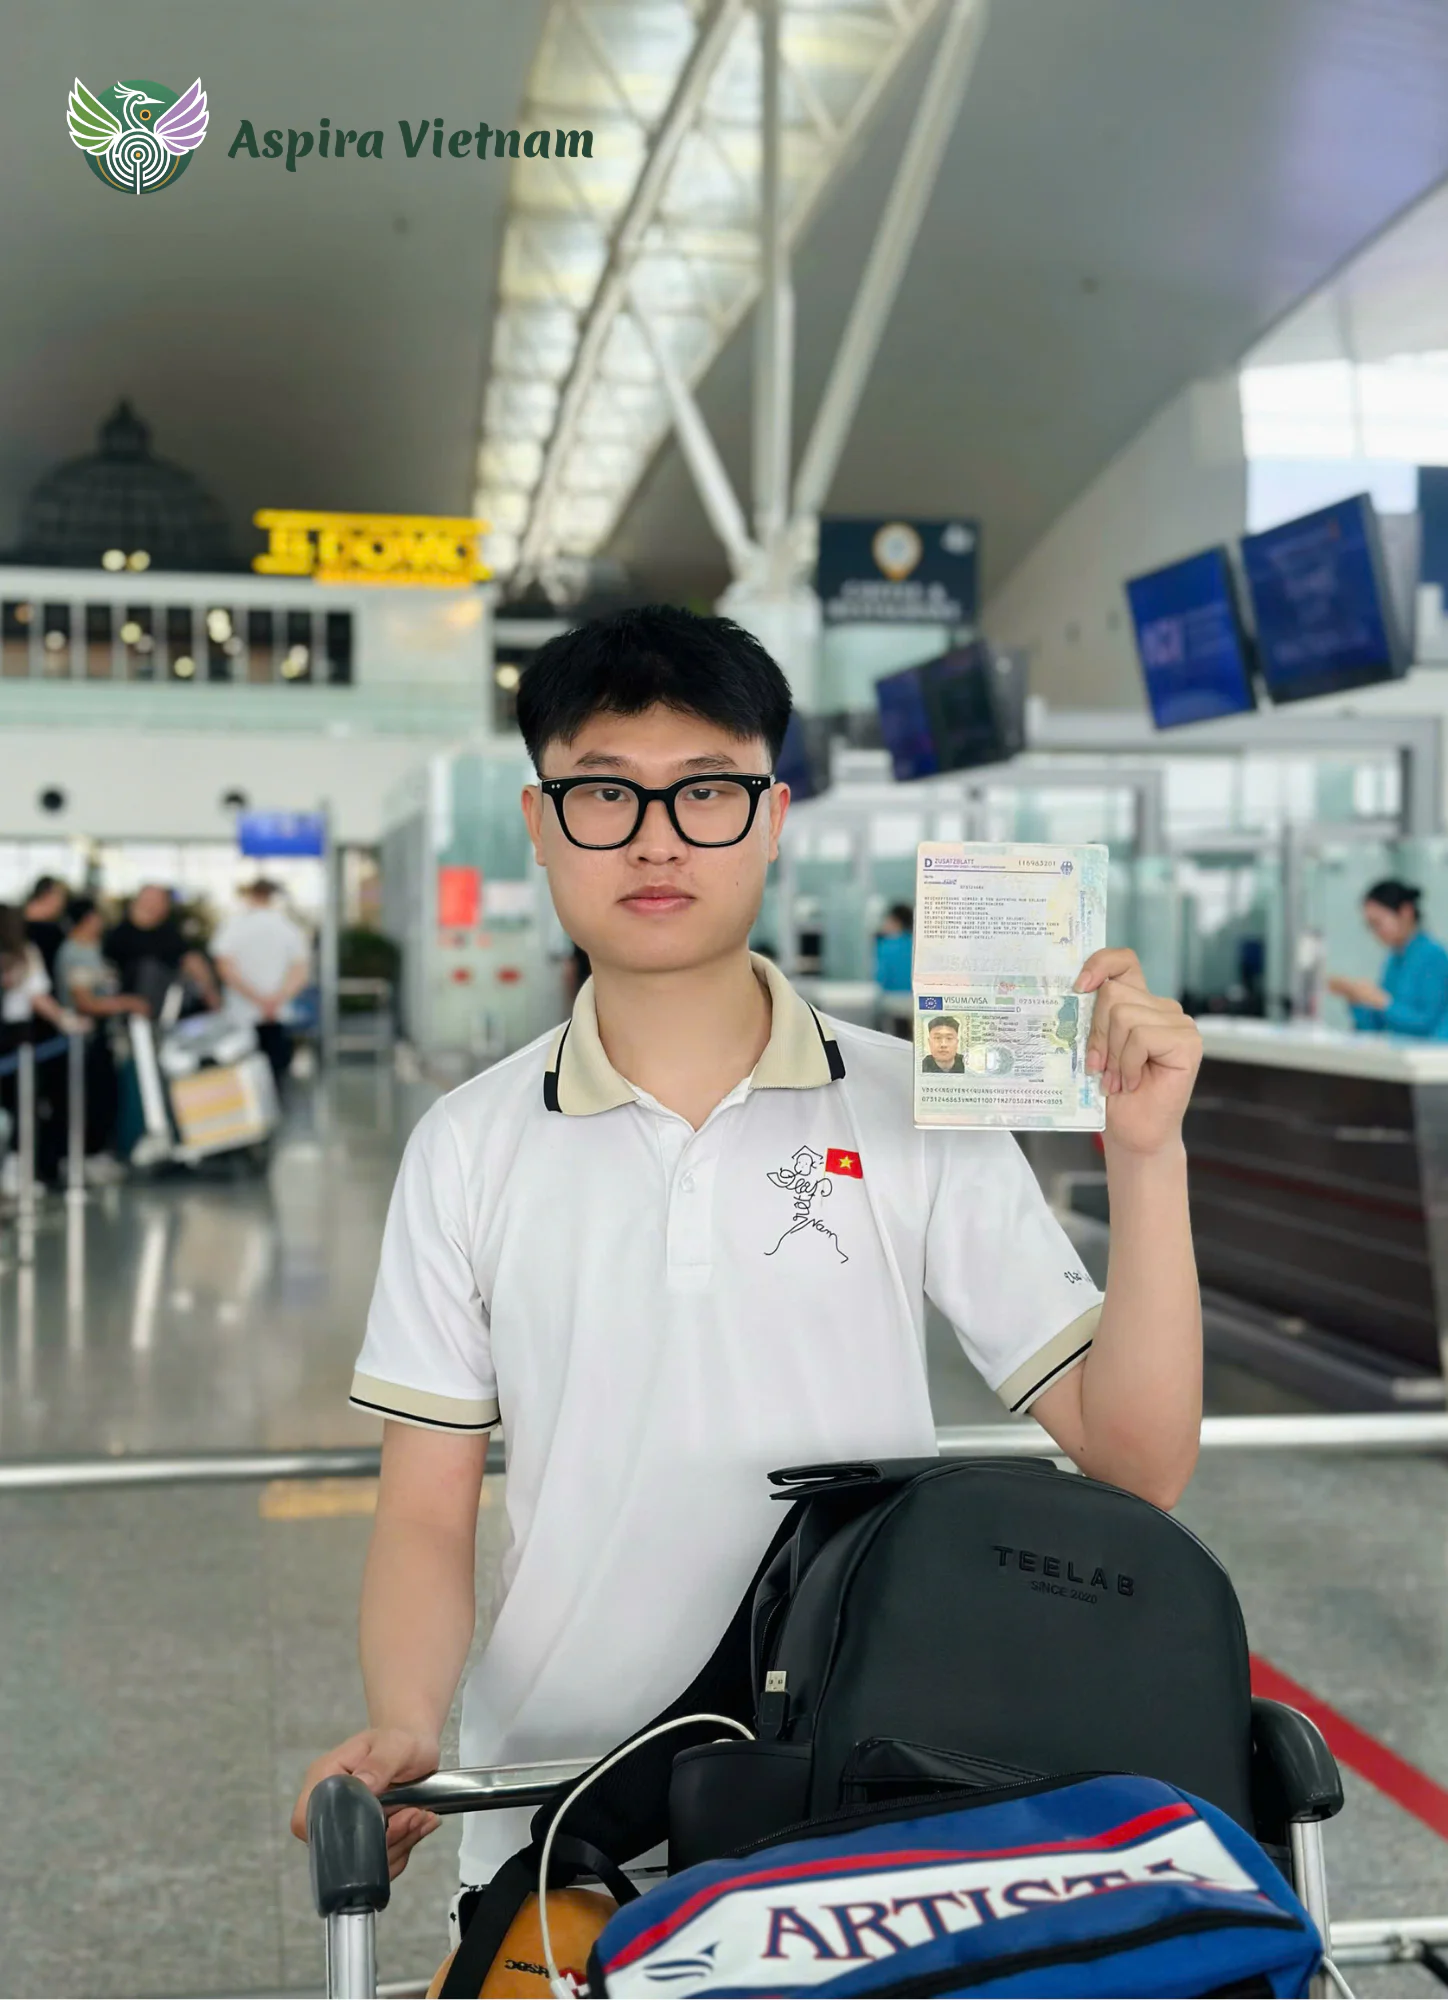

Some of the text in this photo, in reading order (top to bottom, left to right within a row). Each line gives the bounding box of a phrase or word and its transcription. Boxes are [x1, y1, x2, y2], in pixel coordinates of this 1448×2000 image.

[924, 858, 933, 868] D
[944, 997, 988, 1005] VISUM/VISA
[991, 1545, 1135, 1597] TEELAB
[1030, 1580, 1098, 1605] SINCE 2020
